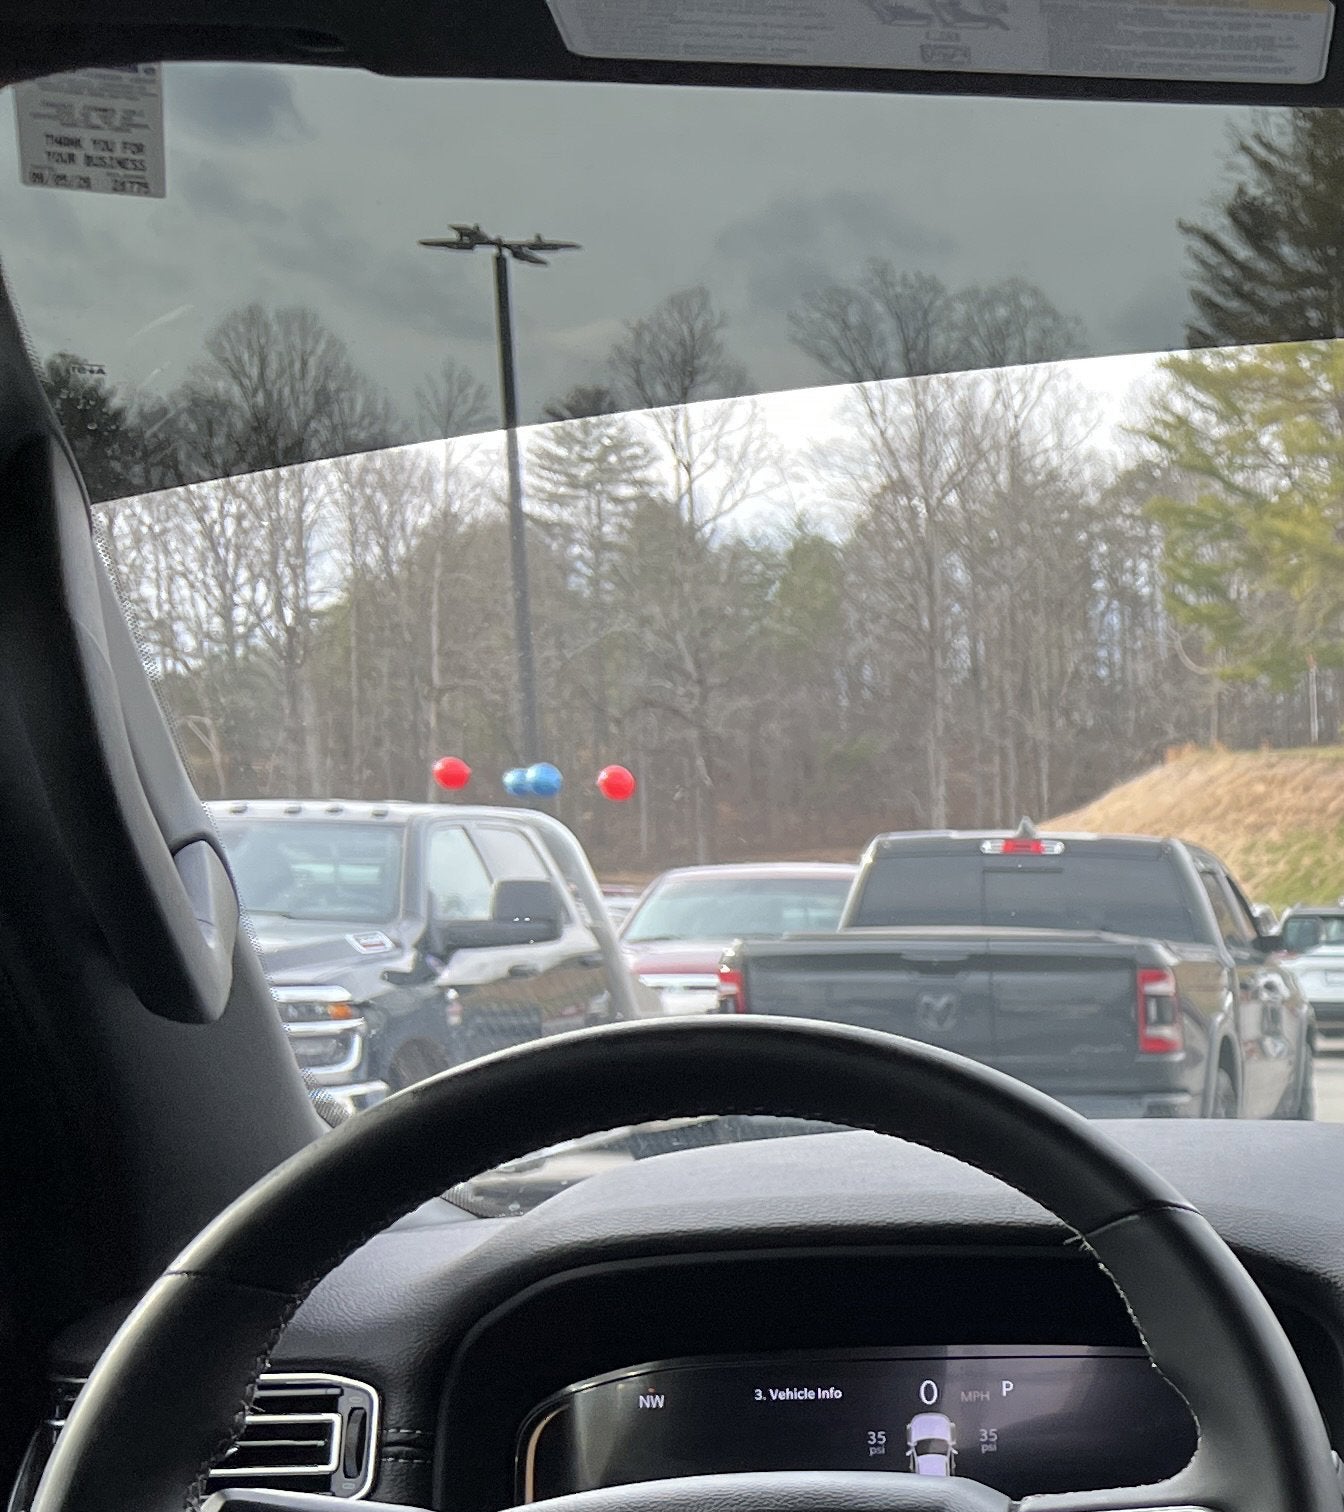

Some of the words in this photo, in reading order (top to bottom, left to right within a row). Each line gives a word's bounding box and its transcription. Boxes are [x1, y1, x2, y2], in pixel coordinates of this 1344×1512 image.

[754, 1389, 767, 1401] 3.
[769, 1388, 815, 1401] Vehicle
[816, 1388, 842, 1400] Info
[919, 1379, 937, 1405] 0
[960, 1390, 991, 1403] MPH
[1002, 1380, 1013, 1396] P
[639, 1394, 665, 1409] NW
[867, 1431, 887, 1445] 35
[979, 1428, 998, 1442] 35
[869, 1445, 886, 1457] psi
[980, 1442, 997, 1455] psi
